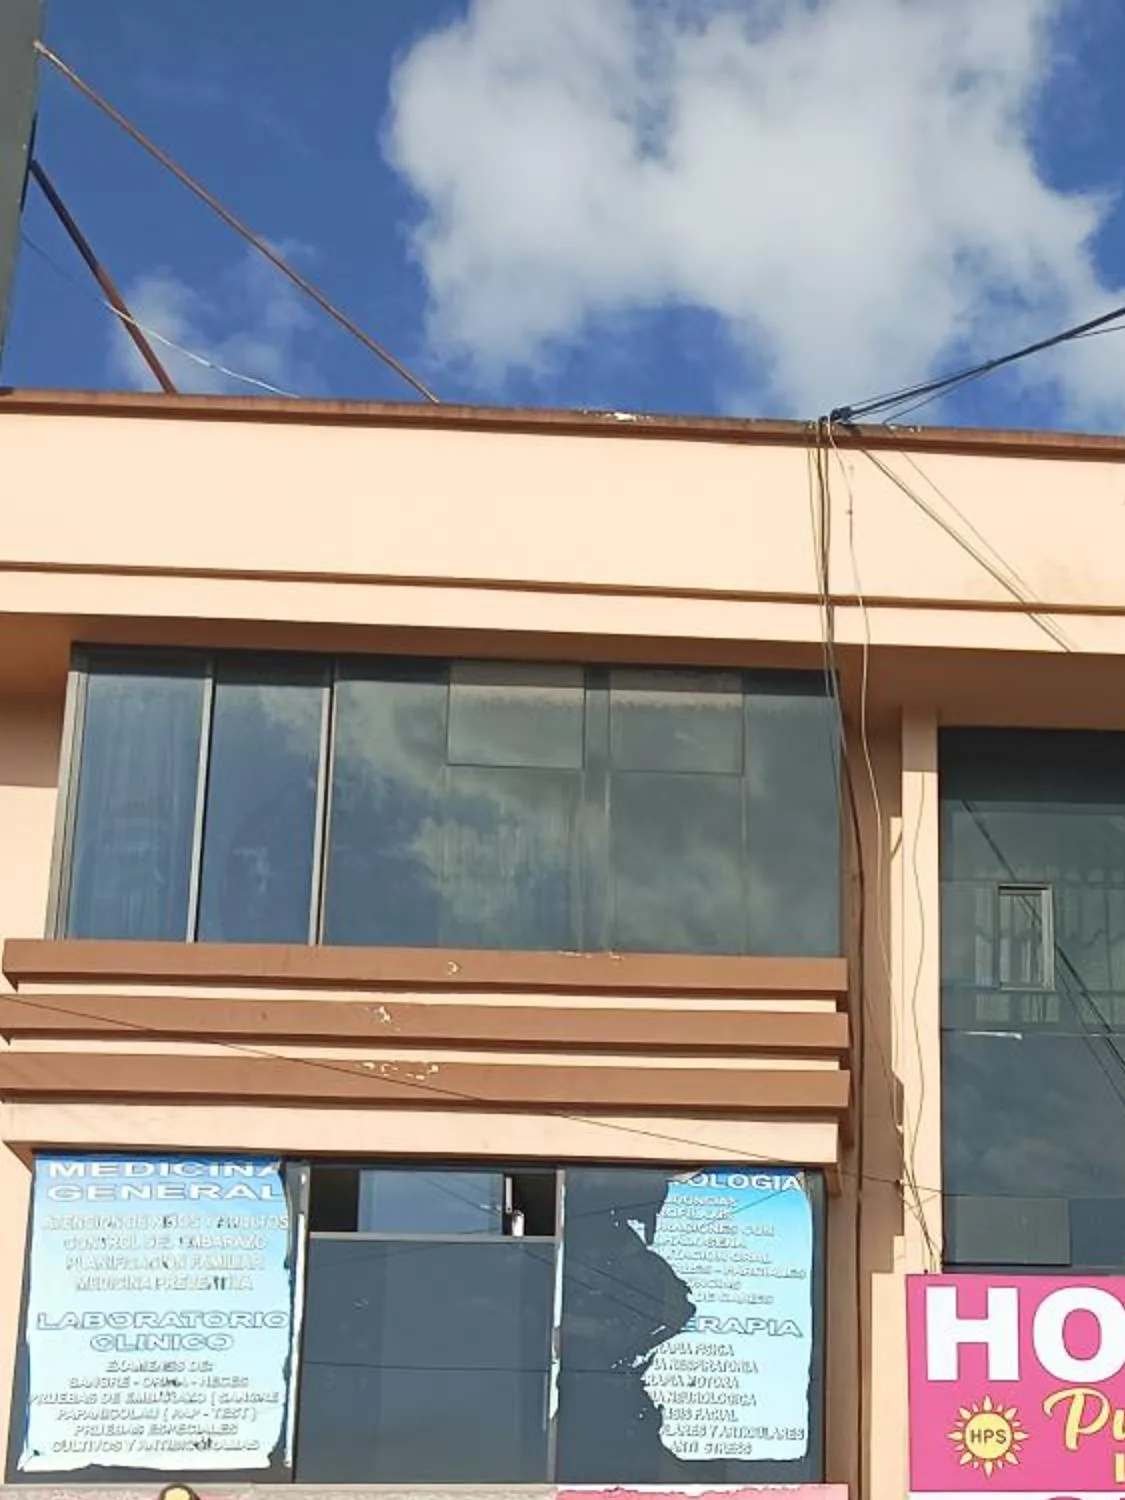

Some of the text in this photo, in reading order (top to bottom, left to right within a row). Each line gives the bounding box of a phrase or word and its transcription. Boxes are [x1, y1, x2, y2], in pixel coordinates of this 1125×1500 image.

[674, 1172, 801, 1190] OLOGIA
[48, 1184, 284, 1201] GENERAL
[36, 1311, 290, 1331] LABORATORIO
[90, 1333, 234, 1352] CLINICO
[969, 1428, 1007, 1445] HPS
